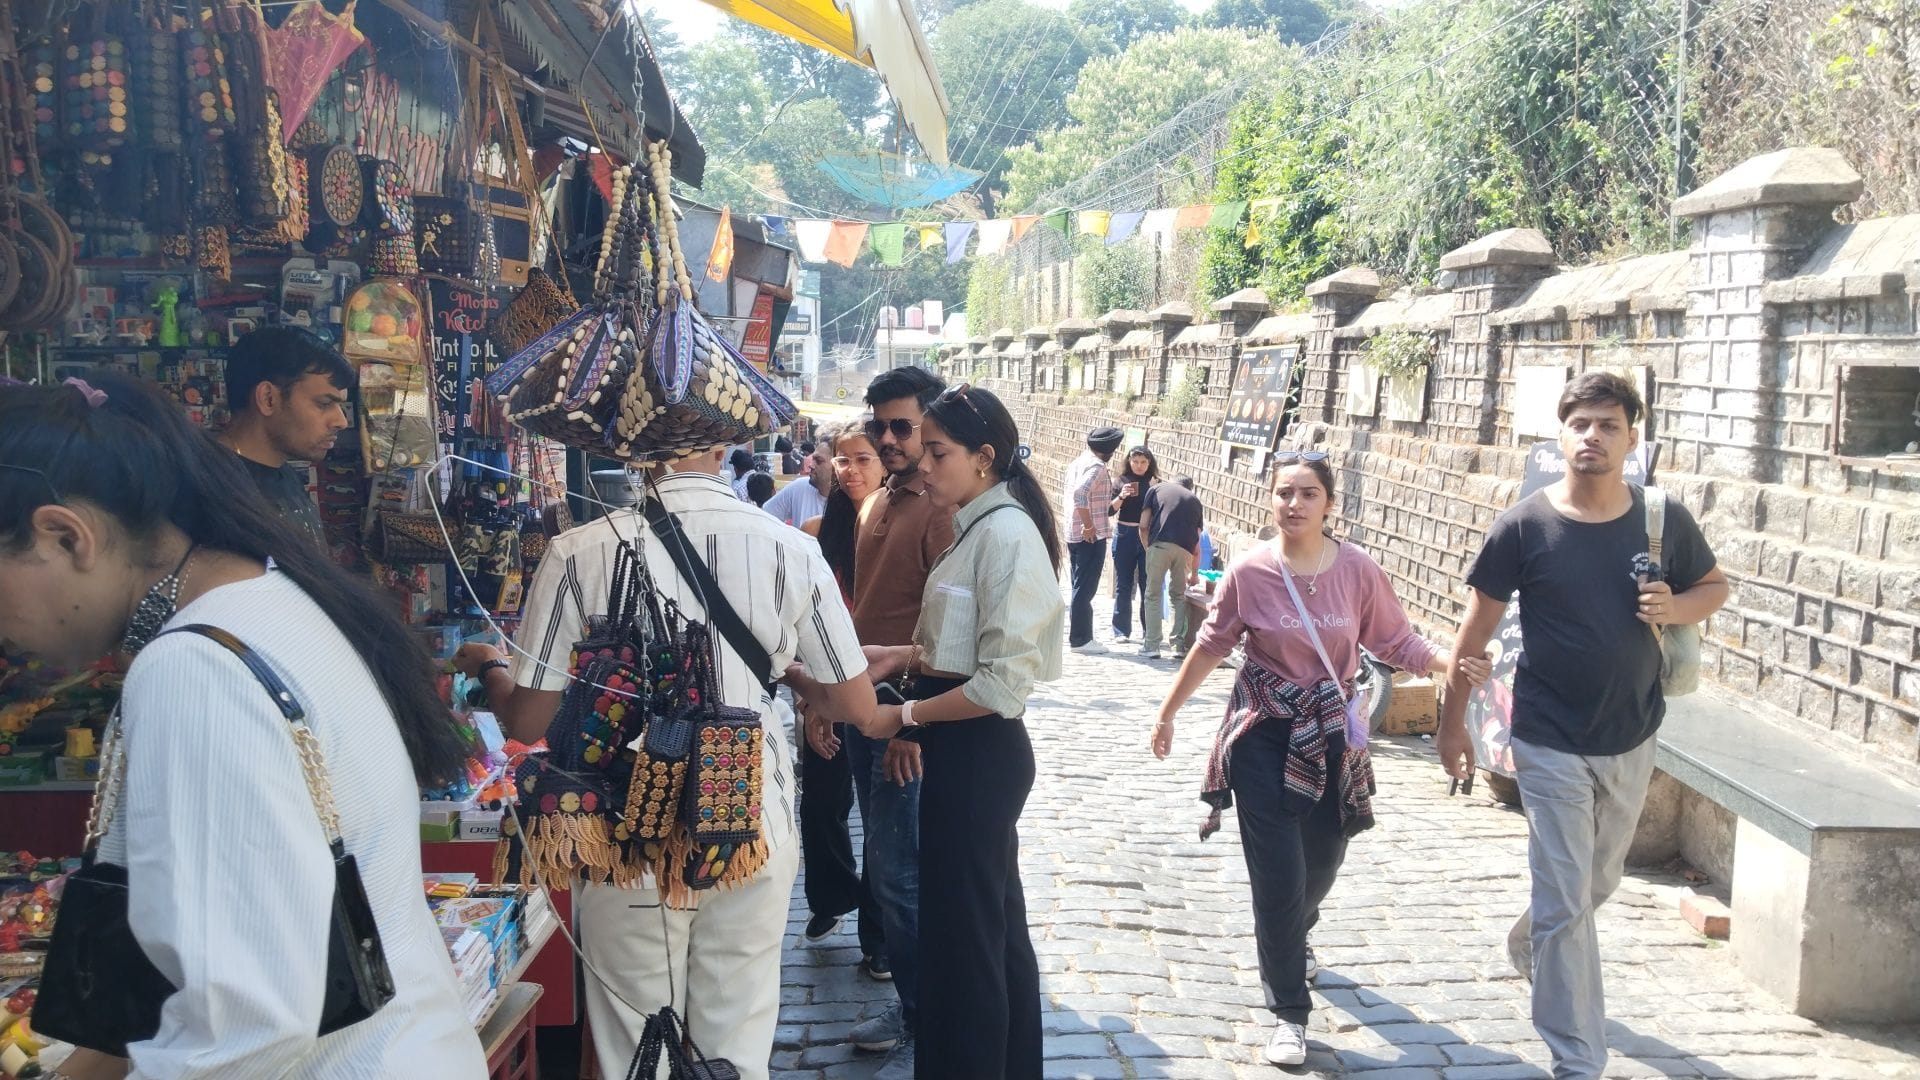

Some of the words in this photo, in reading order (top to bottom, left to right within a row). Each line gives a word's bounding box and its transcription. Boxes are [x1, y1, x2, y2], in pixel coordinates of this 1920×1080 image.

[784, 322, 809, 331] ESTAURANT
[447, 361, 478, 372] FIT
[1323, 612, 1352, 628] Klein
